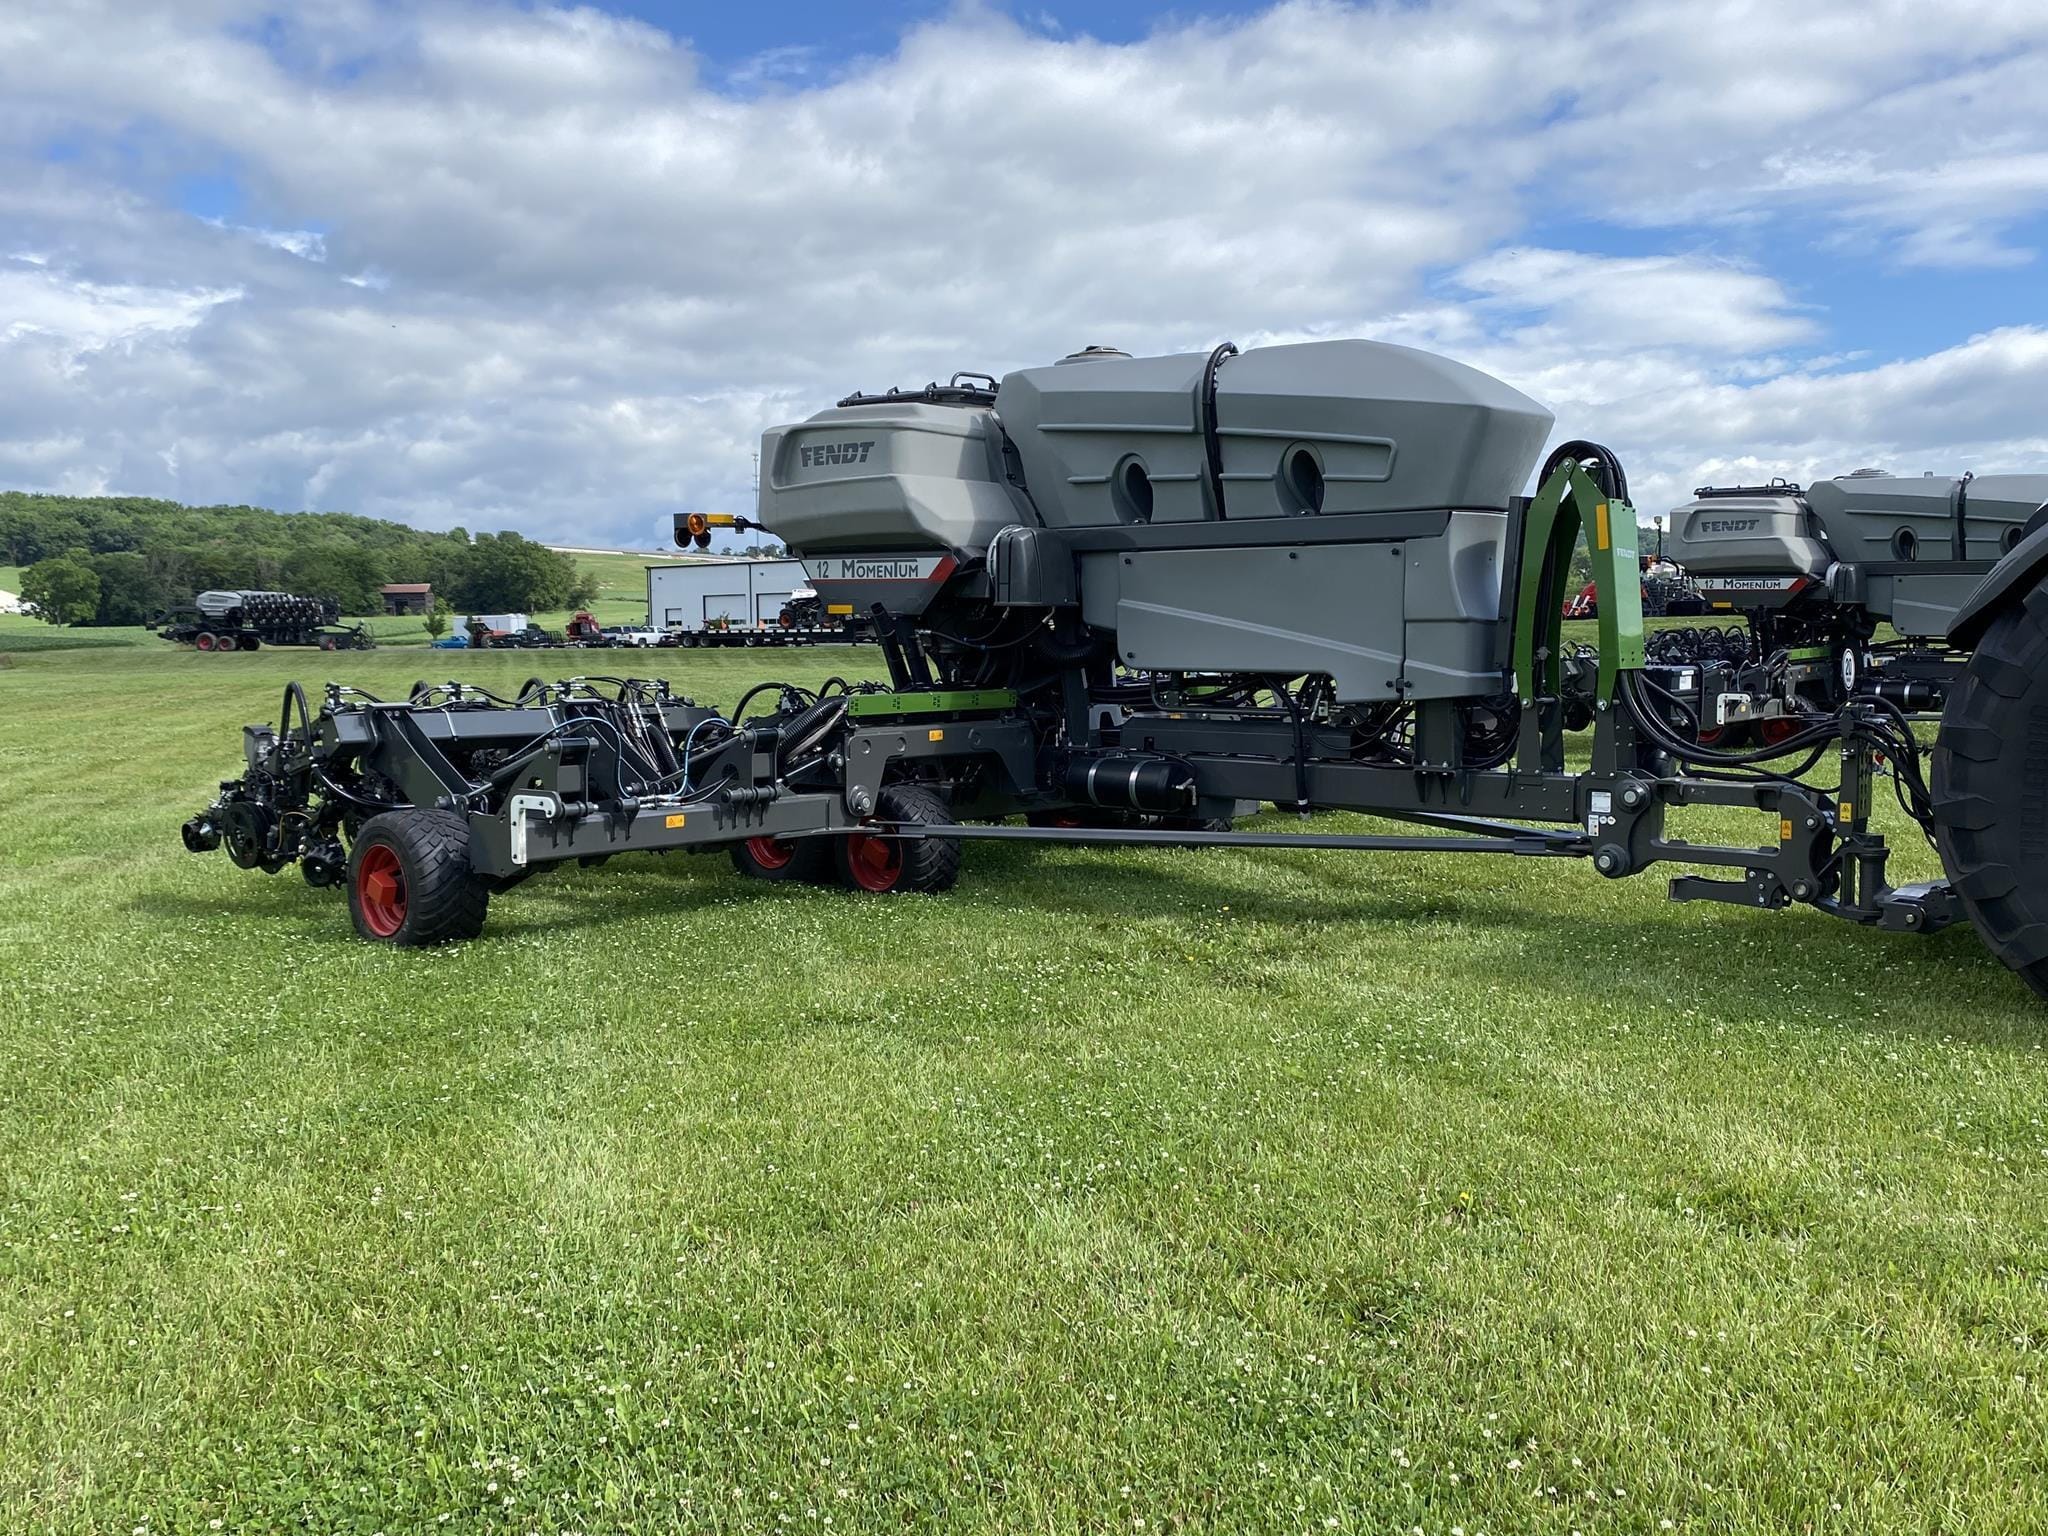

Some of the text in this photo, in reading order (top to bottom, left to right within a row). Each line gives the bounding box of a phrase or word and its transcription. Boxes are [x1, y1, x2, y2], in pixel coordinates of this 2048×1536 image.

[801, 442, 875, 467] FENDT
[1701, 520, 1760, 532] FENDT
[816, 559, 919, 578] 12 MOMENTUM
[1704, 578, 1781, 589] 12 MOMENTUM
